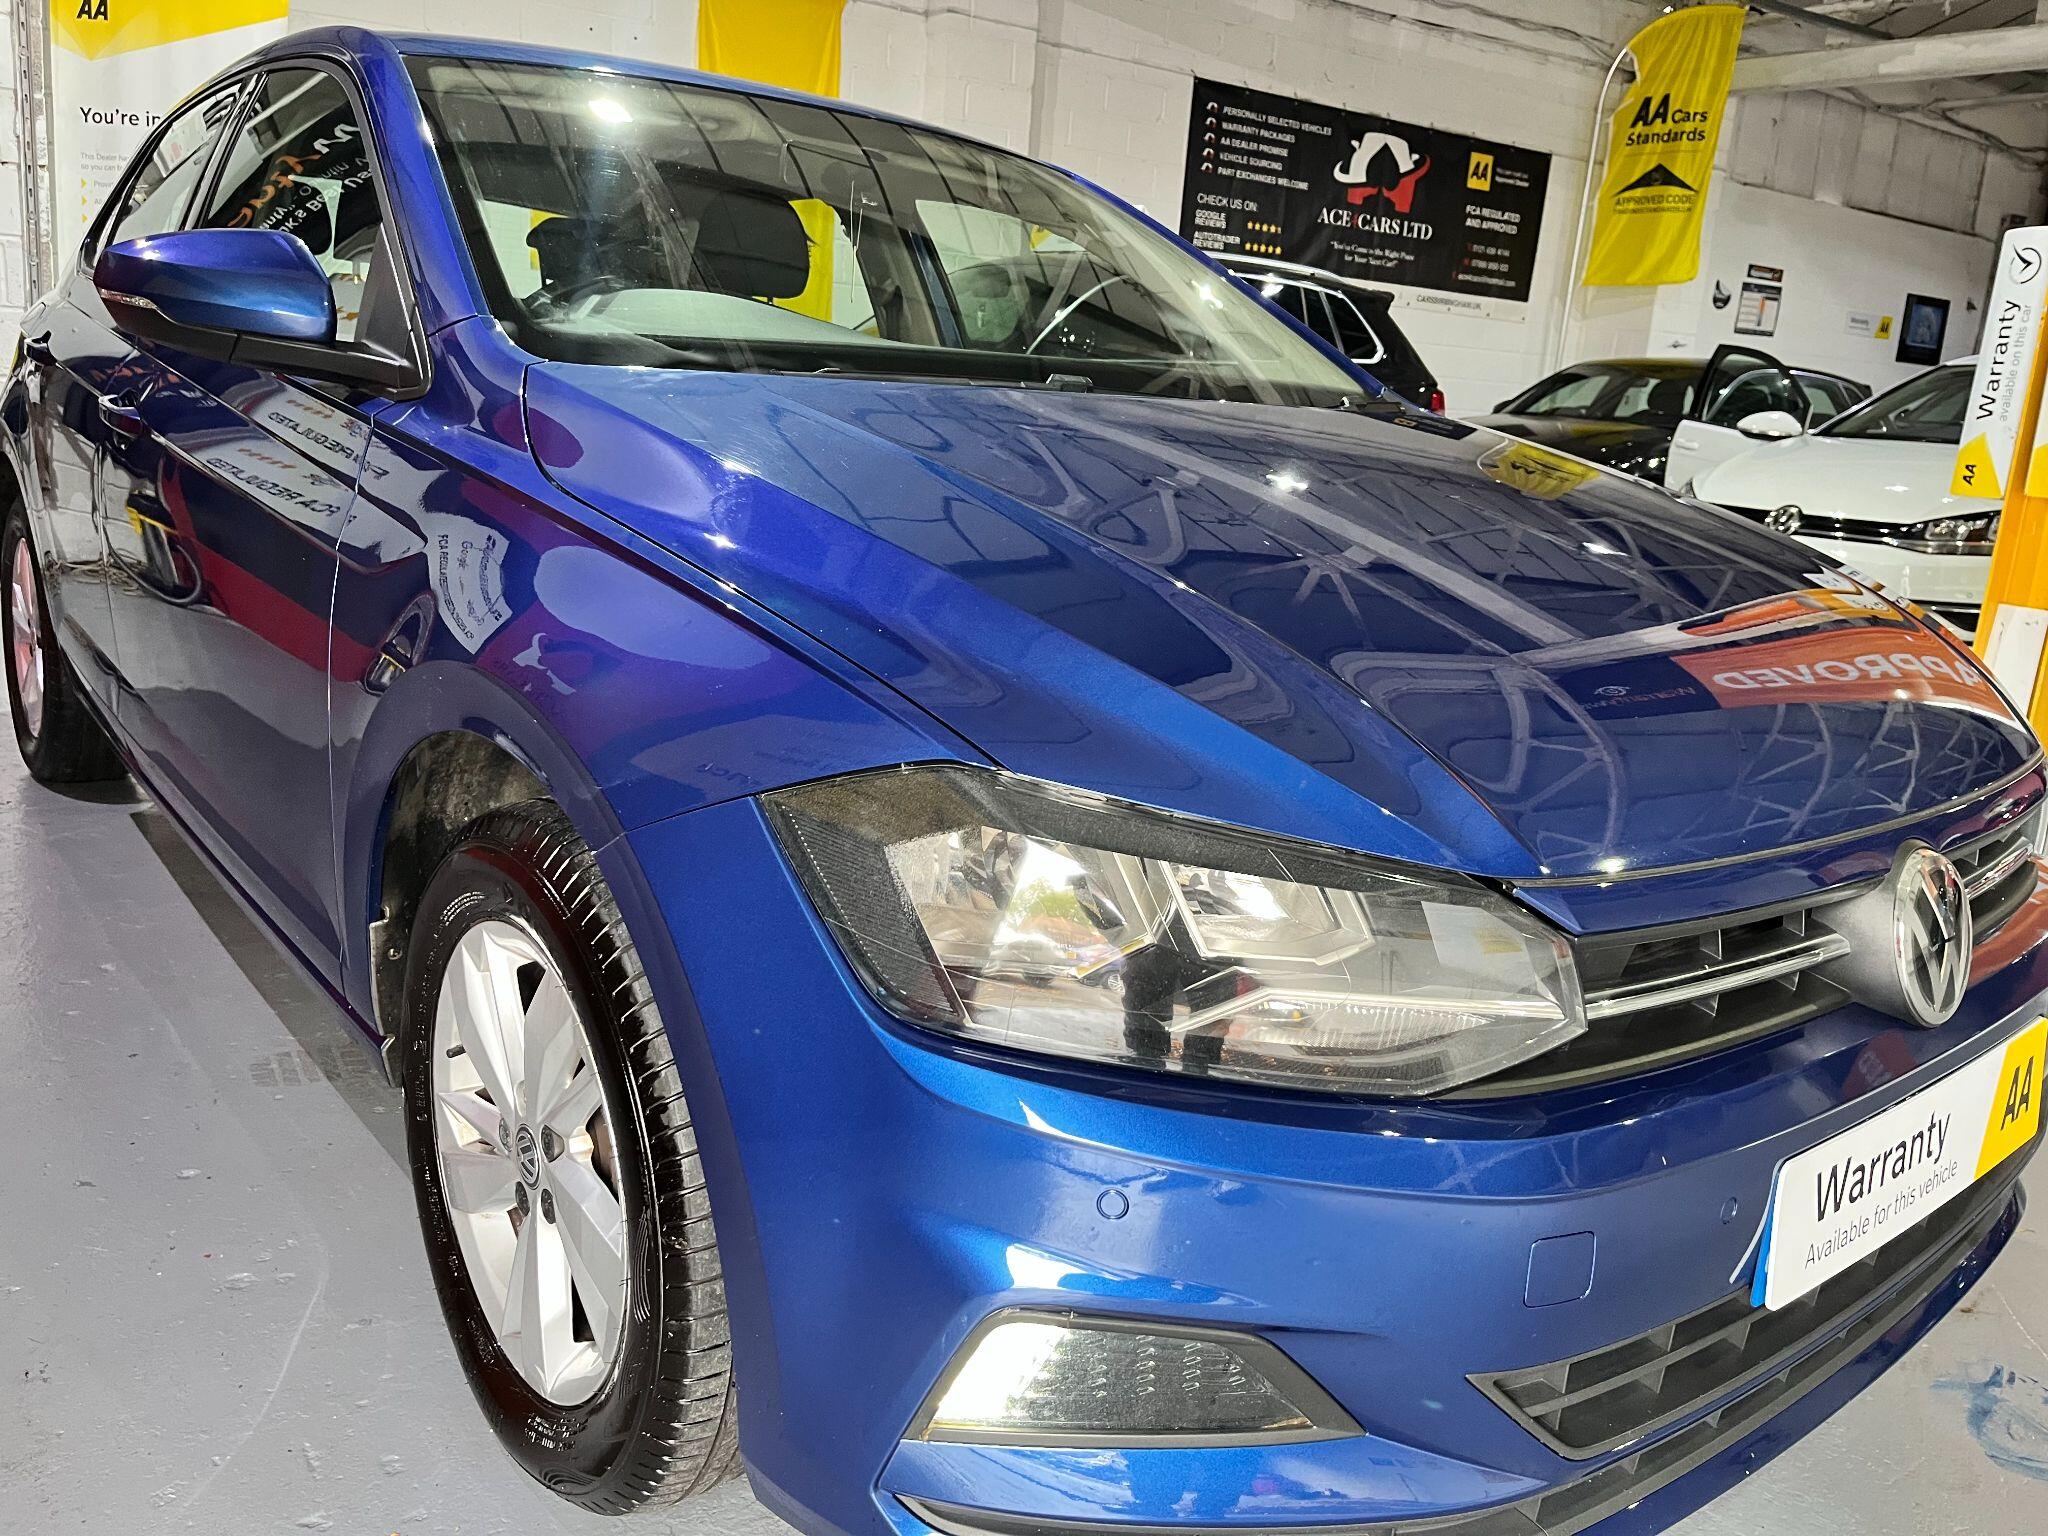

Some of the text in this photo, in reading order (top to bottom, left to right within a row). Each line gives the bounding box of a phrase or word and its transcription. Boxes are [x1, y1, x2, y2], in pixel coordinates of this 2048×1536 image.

[76, 0, 109, 21] AA
[79, 106, 140, 126] You're
[1223, 105, 1332, 136] PERSONALLY SELECTED VEHICLES
[1629, 92, 1708, 129] AA Cars
[1221, 121, 1295, 143] WARRANTY PACKAGES
[1625, 127, 1706, 147] Standards
[1231, 138, 1258, 151] DEALER
[1259, 143, 1288, 157] PROMISE
[1219, 151, 1283, 171] VEHICLE SOURCING
[1470, 160, 1489, 182] AA
[1217, 166, 1236, 177] PART
[1277, 177, 1309, 190] WELCOME
[1197, 192, 1229, 207] CHECK
[1229, 199, 1243, 210] US
[1465, 204, 1481, 215] FCA
[1194, 217, 1226, 229] REVIEWS
[1195, 209, 1226, 220] GOOGLE
[1402, 220, 1433, 240] LTD
[1465, 217, 1518, 235] AND APPROVED
[1192, 238, 1224, 250] REVIEWS
[1193, 230, 1240, 245] AUTOTRADER
[1976, 300, 2021, 421] Warranty
[1999, 304, 2032, 422] available on this car
[1962, 463, 1978, 487] AA
[2000, 1055, 2034, 1132] AA
[1817, 1110, 1951, 1222] Warranty
[1804, 1159, 1959, 1270] Available for this vehicle
